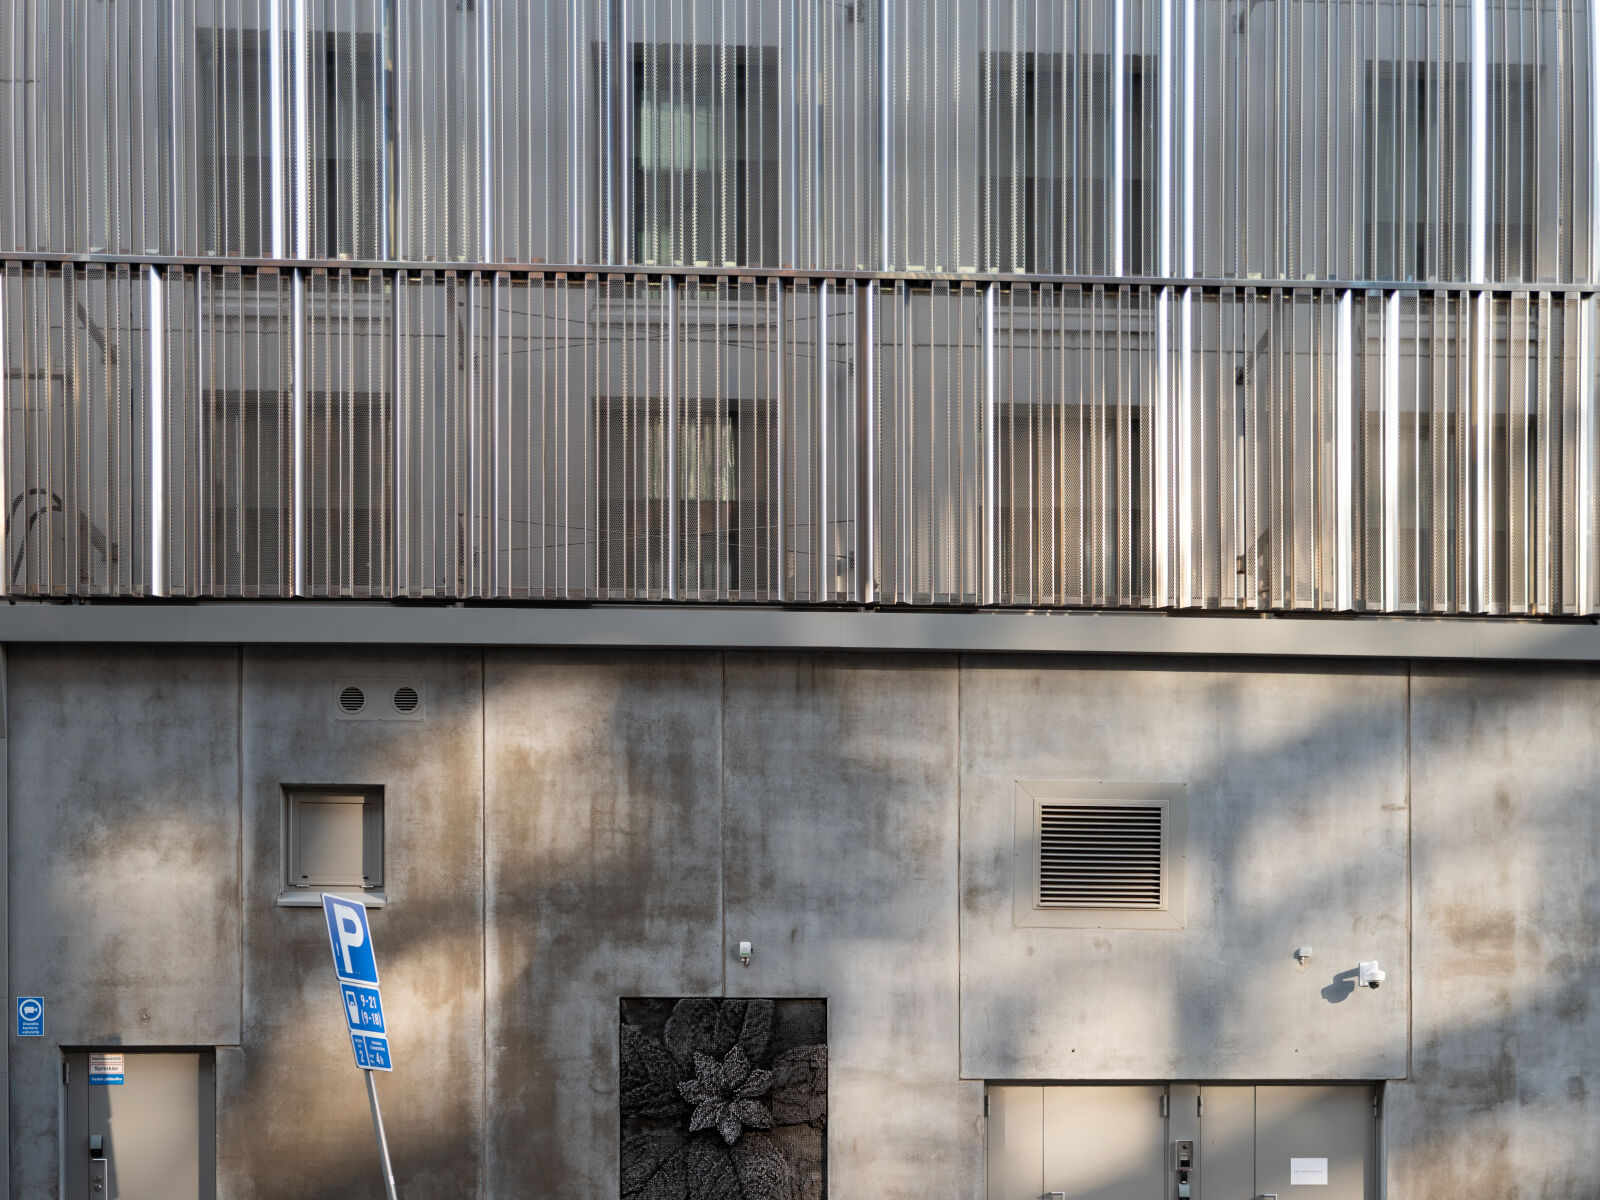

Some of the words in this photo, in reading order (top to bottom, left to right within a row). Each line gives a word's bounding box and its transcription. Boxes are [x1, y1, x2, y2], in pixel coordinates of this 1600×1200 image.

[333, 903, 364, 974] P
[360, 994, 377, 1009] 9-21
[361, 1010, 382, 1028] (9-18)
[359, 1050, 366, 1063] 2
